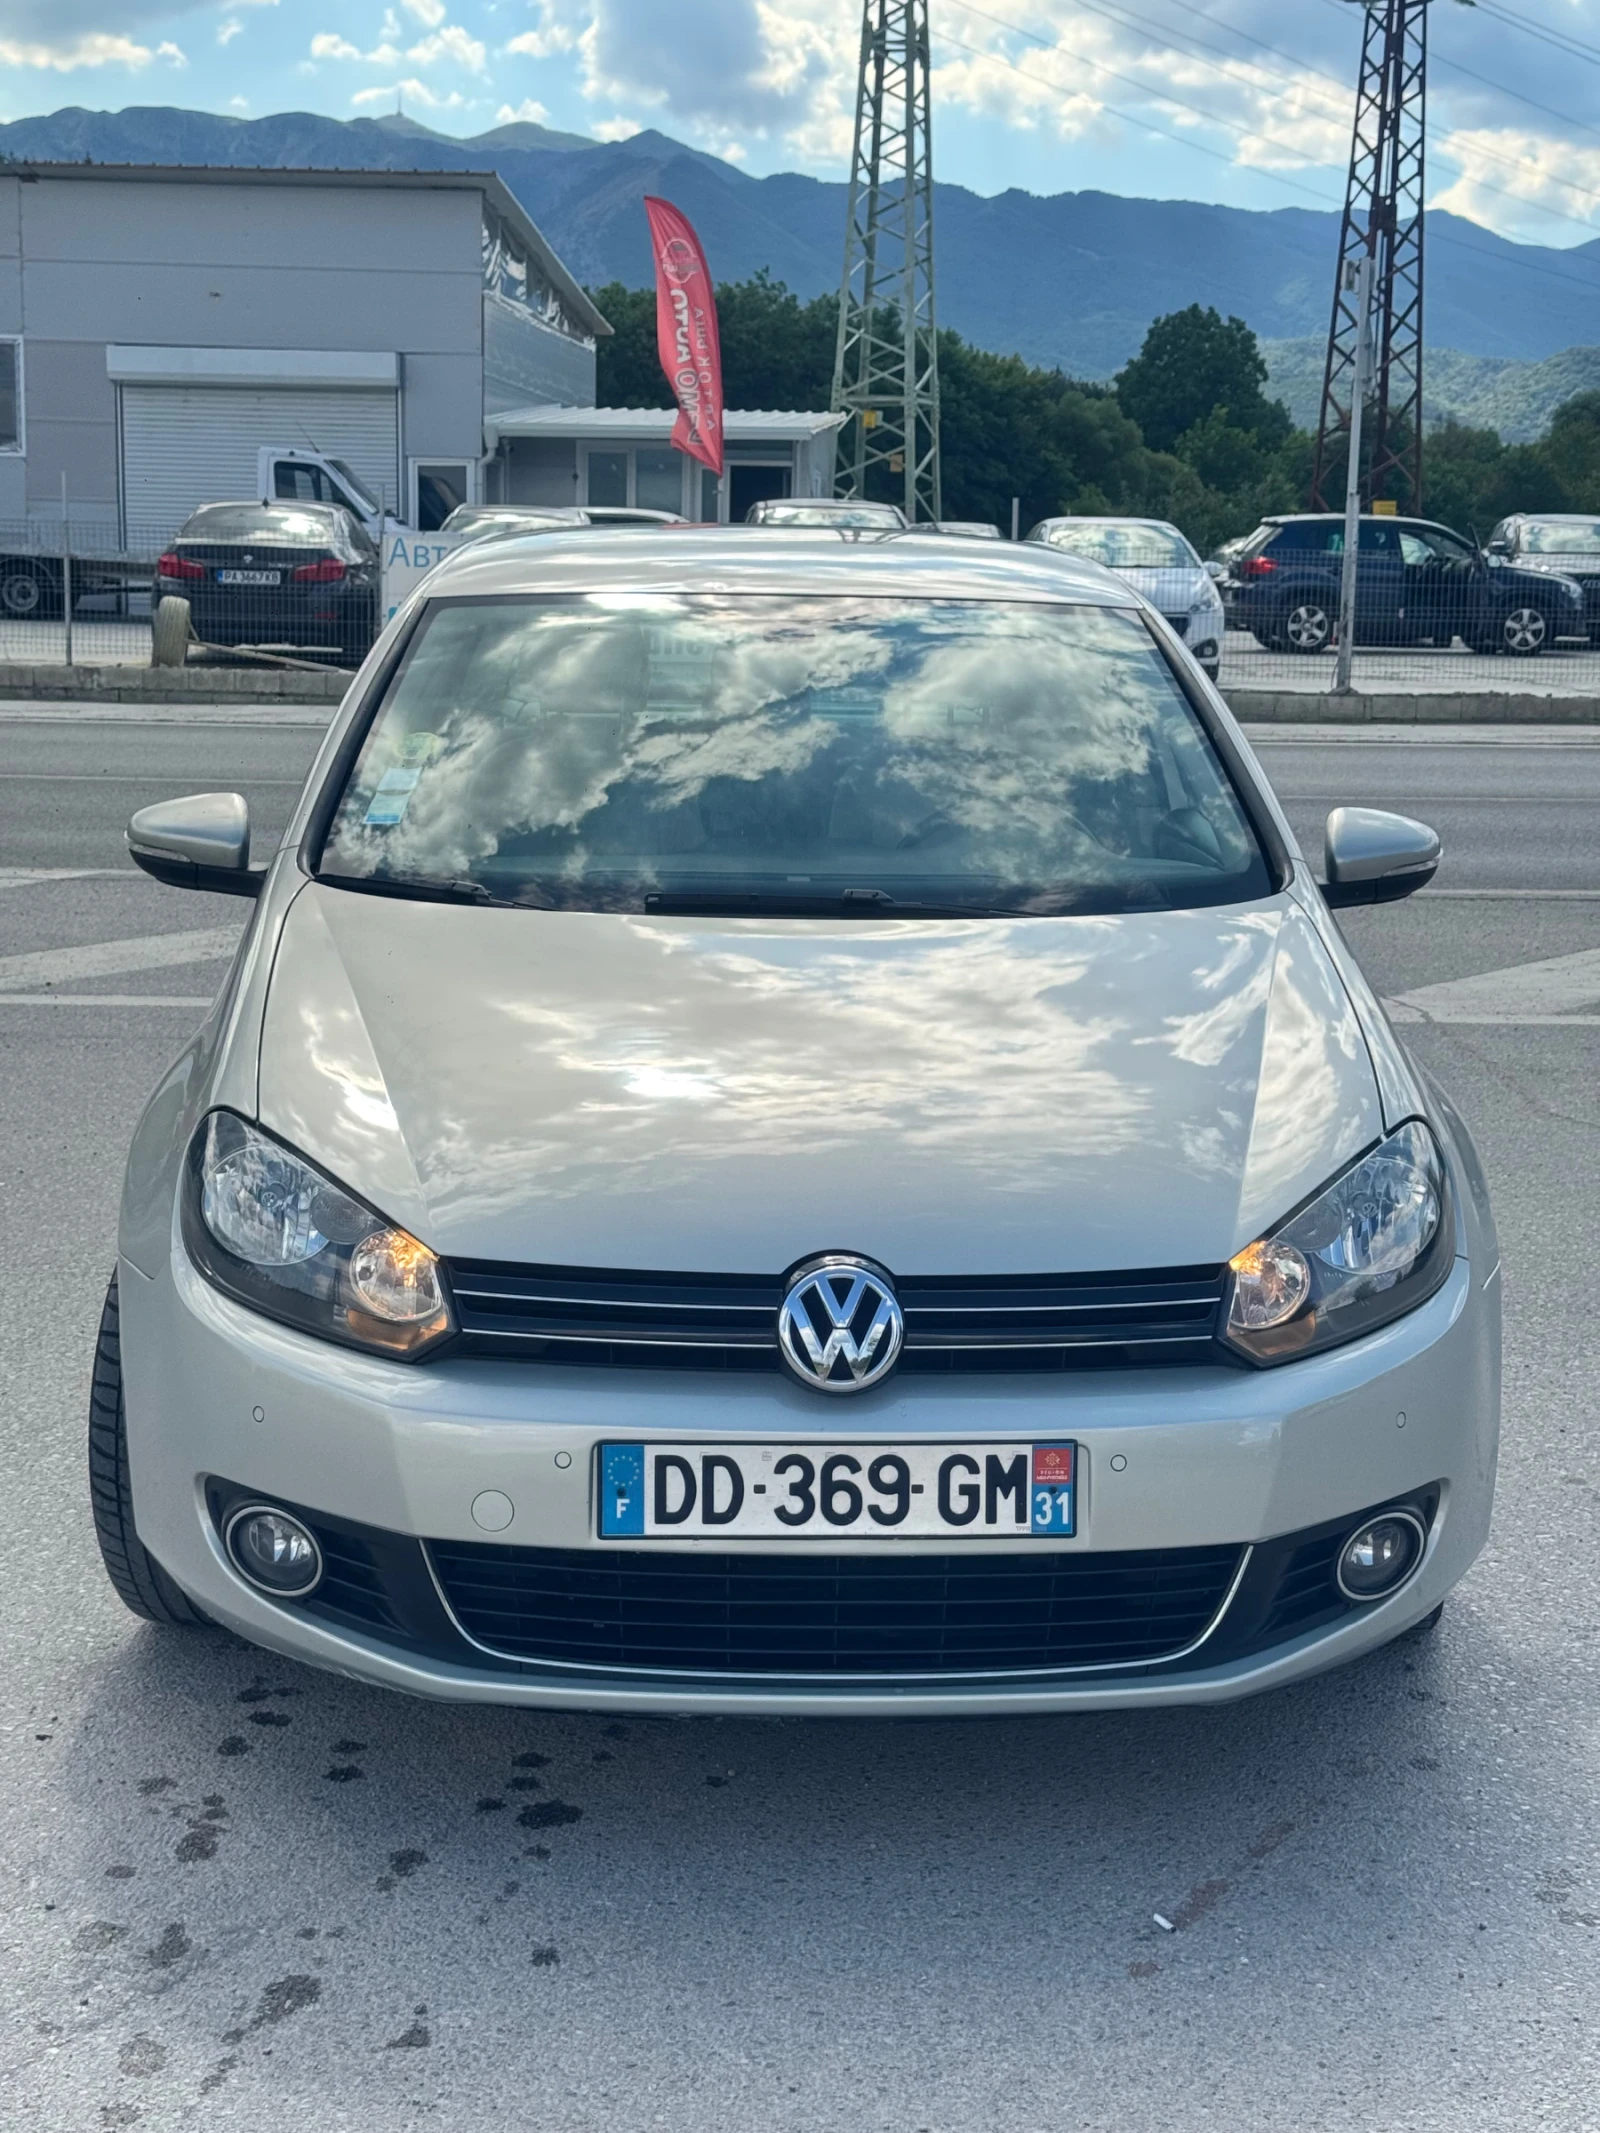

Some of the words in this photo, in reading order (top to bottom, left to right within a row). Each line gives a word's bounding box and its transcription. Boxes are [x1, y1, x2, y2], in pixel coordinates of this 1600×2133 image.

[780, 1265, 902, 1390] VW
[616, 1498, 630, 1519] F
[1035, 1491, 1069, 1525] 31
